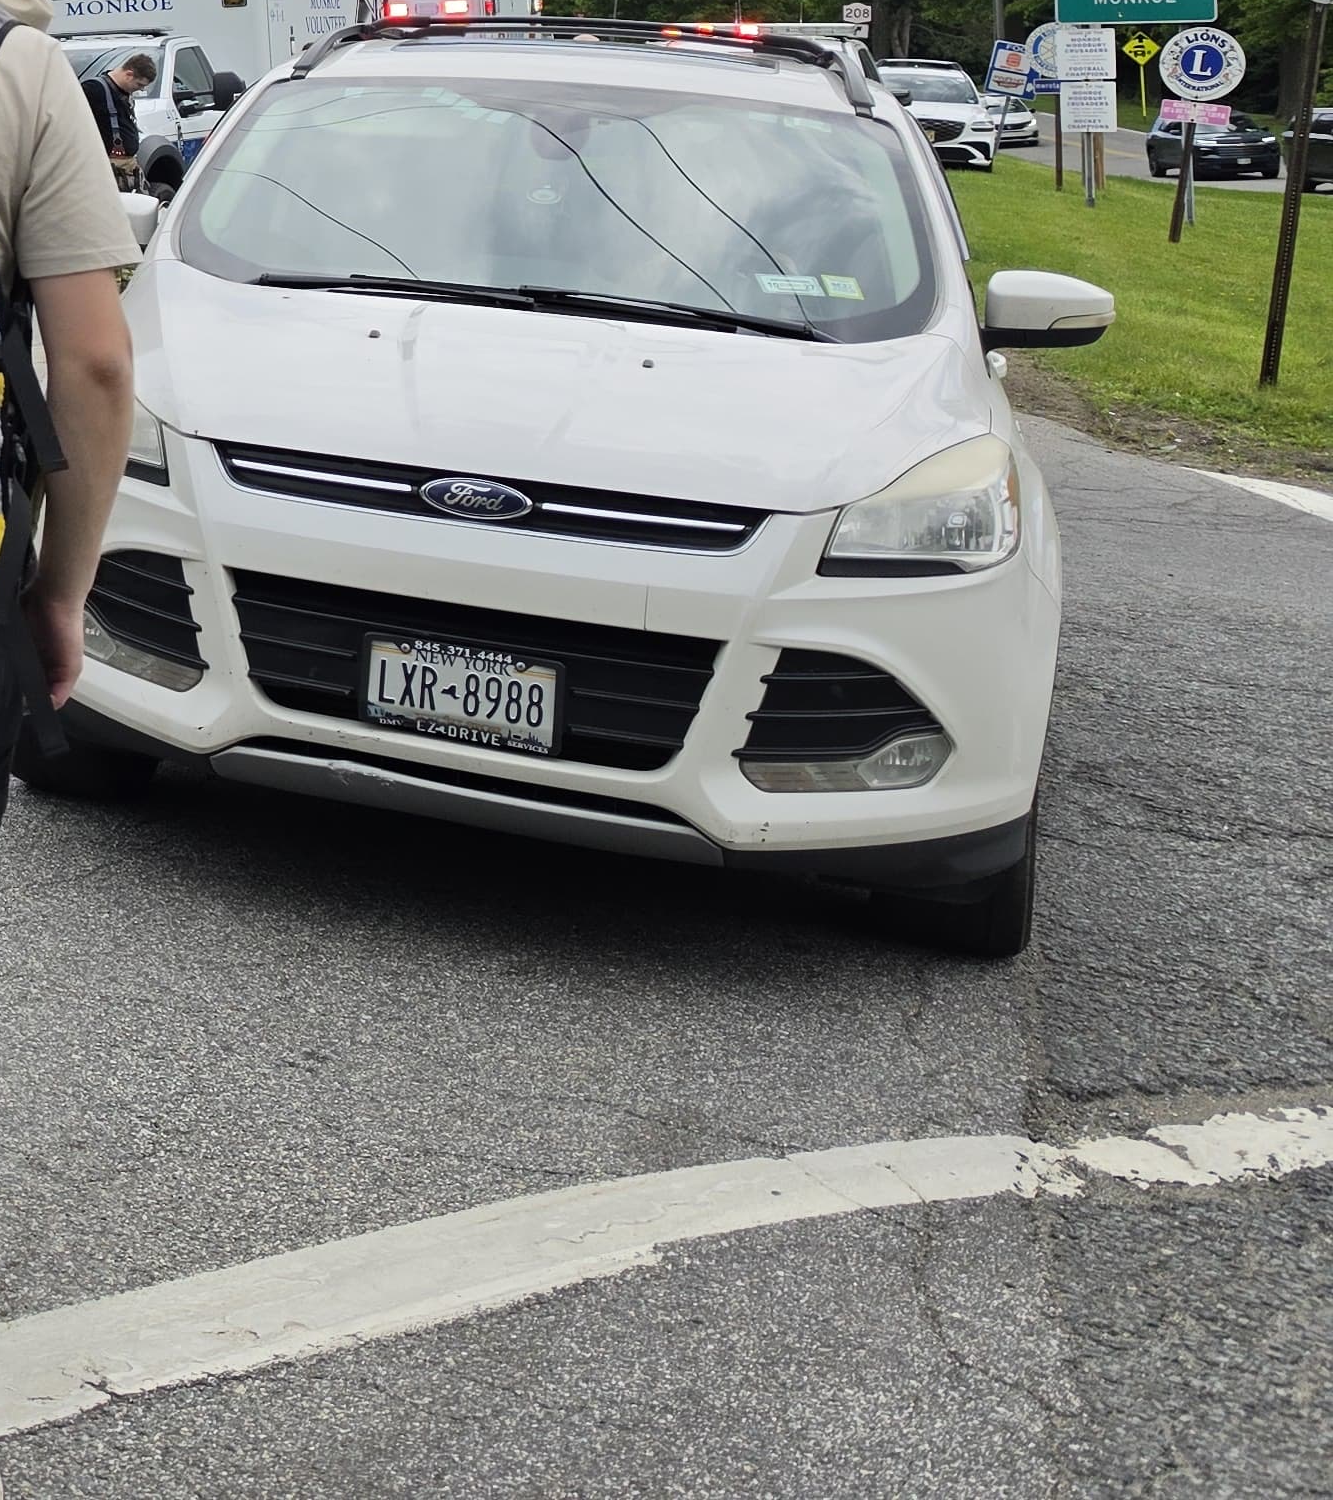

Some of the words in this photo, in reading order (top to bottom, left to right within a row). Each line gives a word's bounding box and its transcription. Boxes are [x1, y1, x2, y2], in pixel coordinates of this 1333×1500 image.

[845, 7, 870, 19] 208
[305, 15, 347, 35] VOLUNTEER
[1185, 32, 1228, 49] LIONS
[1189, 49, 1212, 76] L
[443, 482, 506, 511] Ford
[414, 640, 512, 665] 845.371.4444
[415, 650, 459, 668] NEW
[462, 655, 512, 677] YORK
[378, 717, 404, 726] DMV
[507, 739, 549, 754] SERVICES
